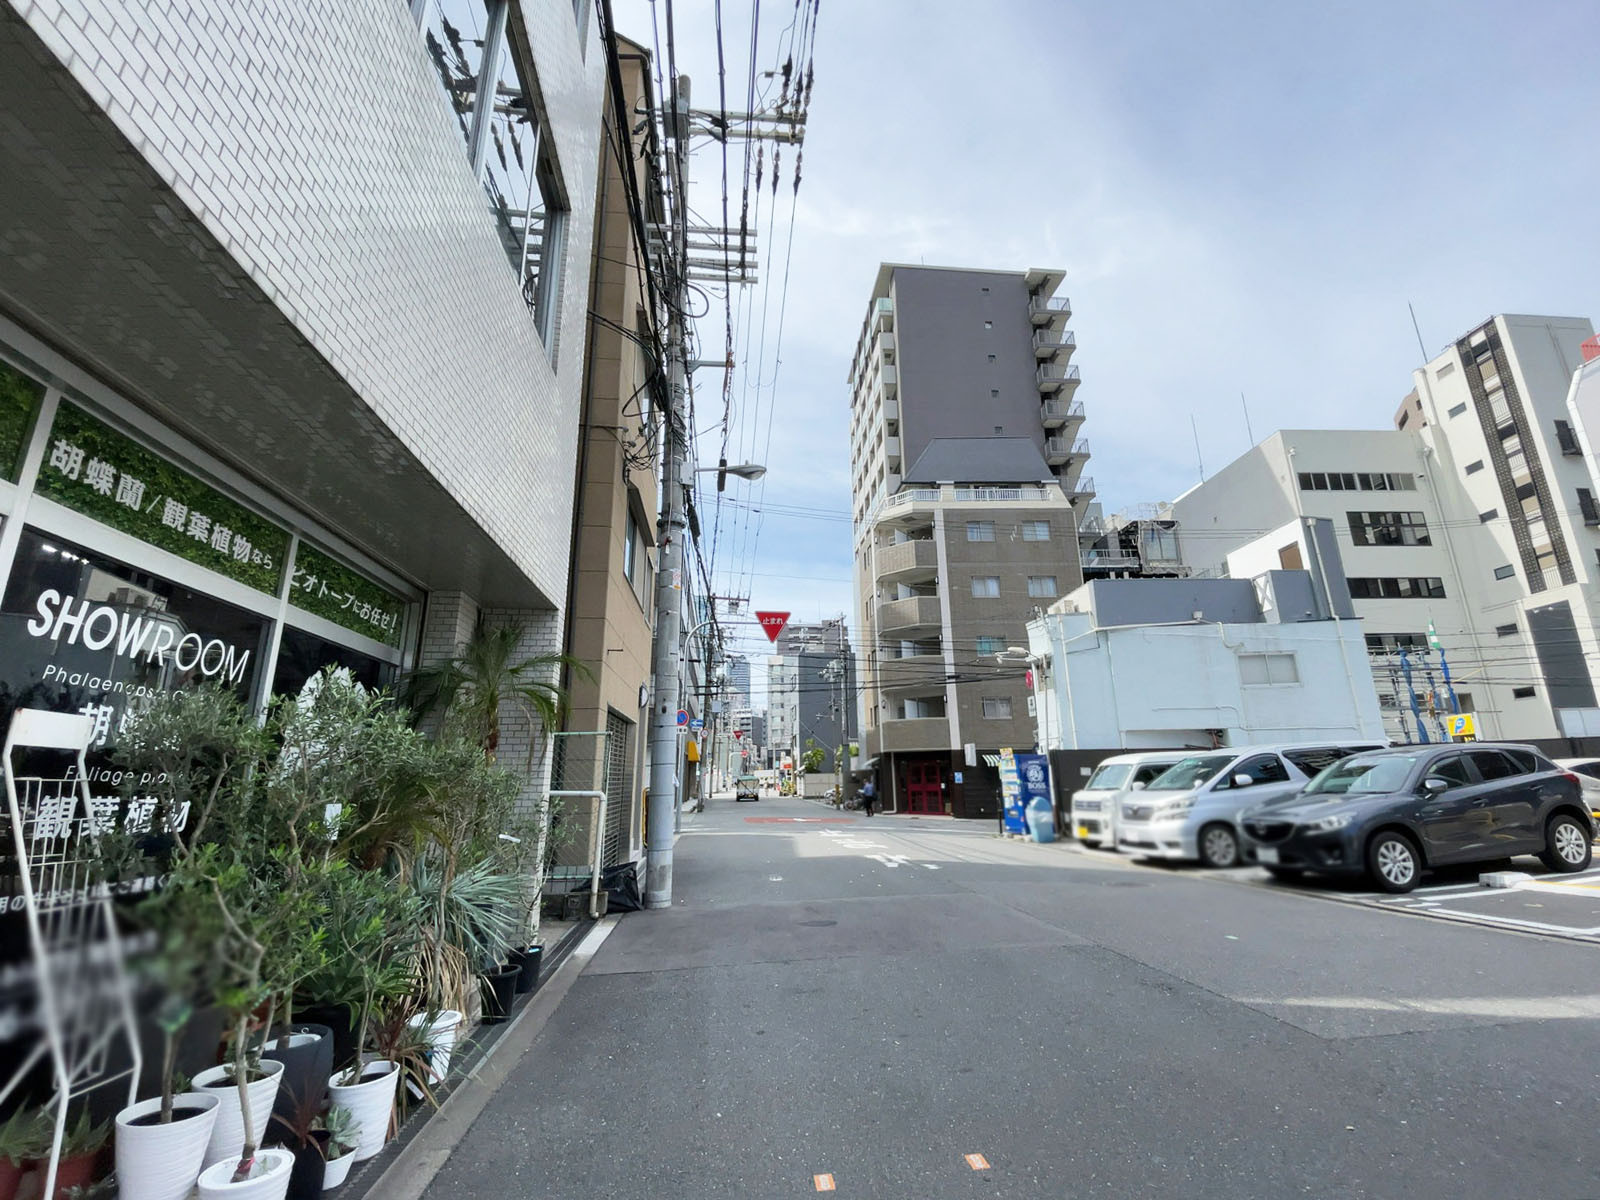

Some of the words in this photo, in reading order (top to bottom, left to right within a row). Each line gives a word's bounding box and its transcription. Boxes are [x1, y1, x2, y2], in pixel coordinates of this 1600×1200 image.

[27, 588, 250, 684] SHOWROOM
[762, 616, 784, 625] 止まれ
